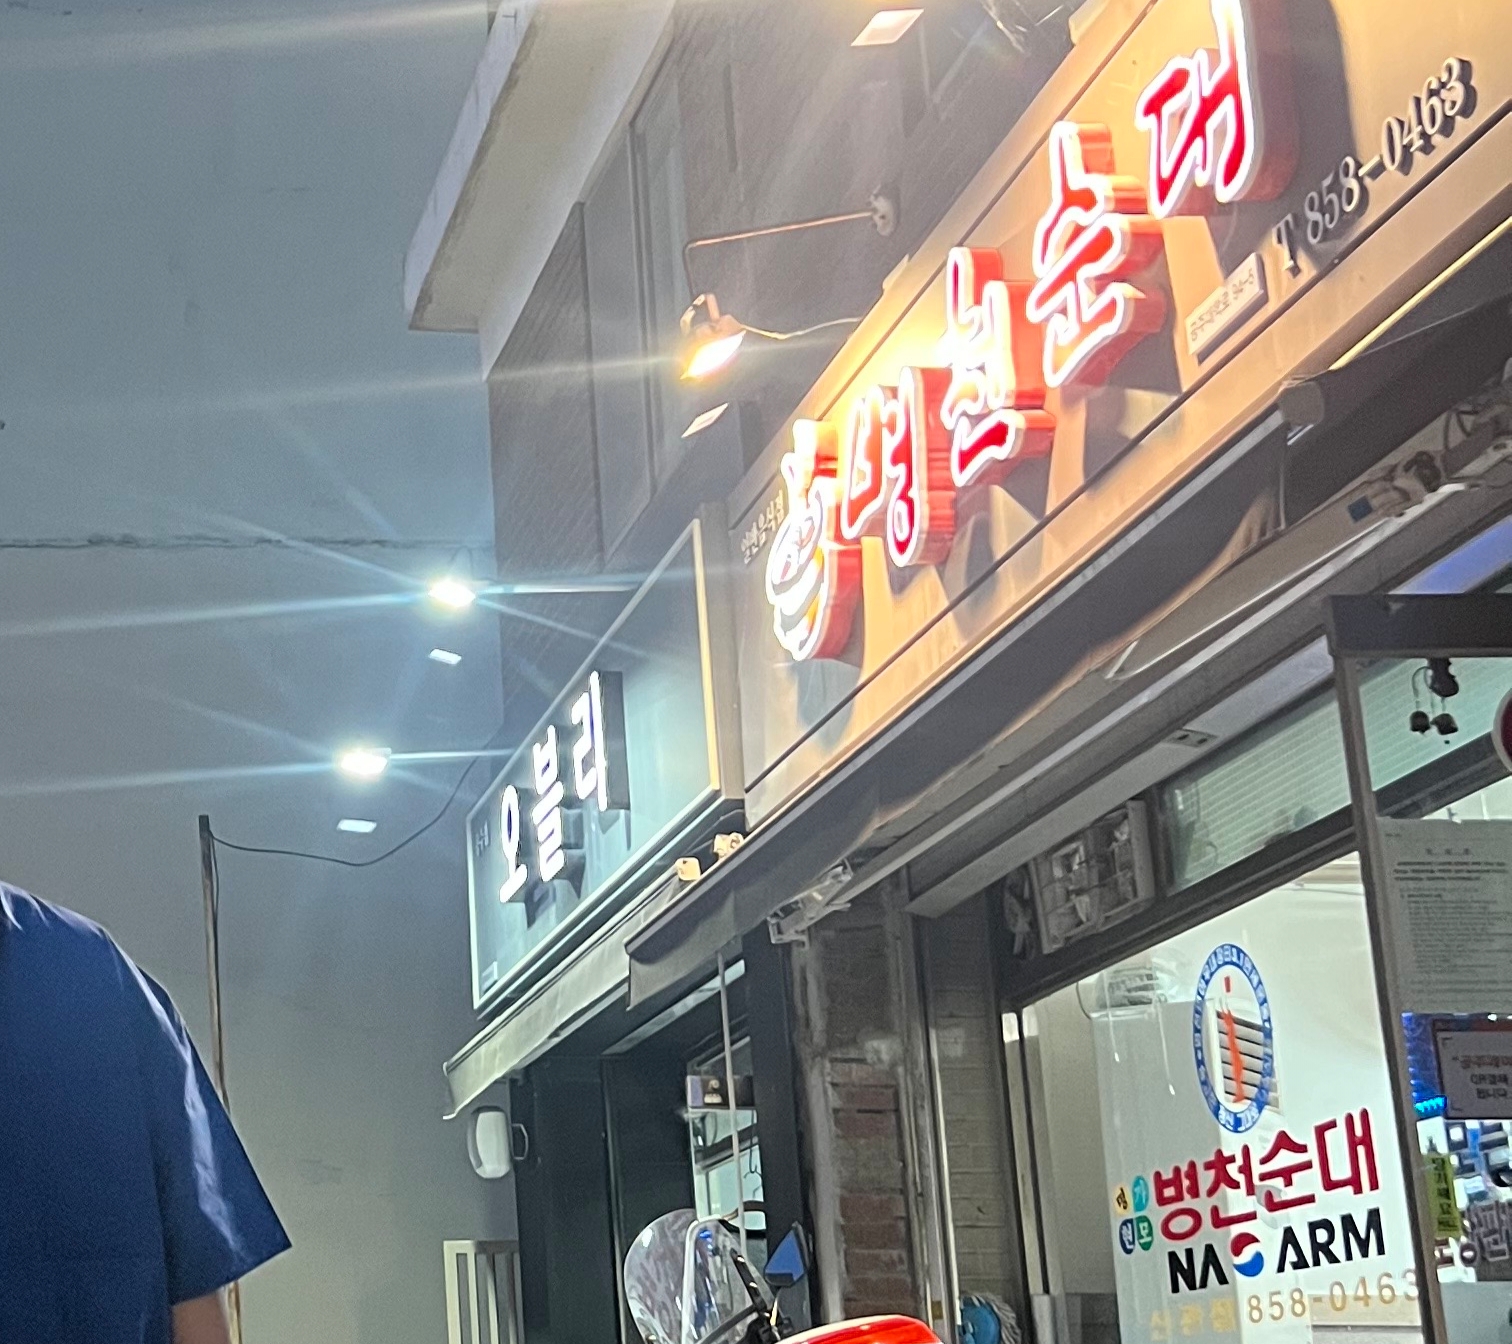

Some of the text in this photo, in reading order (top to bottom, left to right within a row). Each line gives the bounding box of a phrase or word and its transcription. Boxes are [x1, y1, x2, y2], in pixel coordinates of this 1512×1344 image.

[1304, 56, 1470, 245] 858-0463
[1153, 1107, 1380, 1242] 병천순대
[1247, 1267, 1419, 1324] 858-0463
